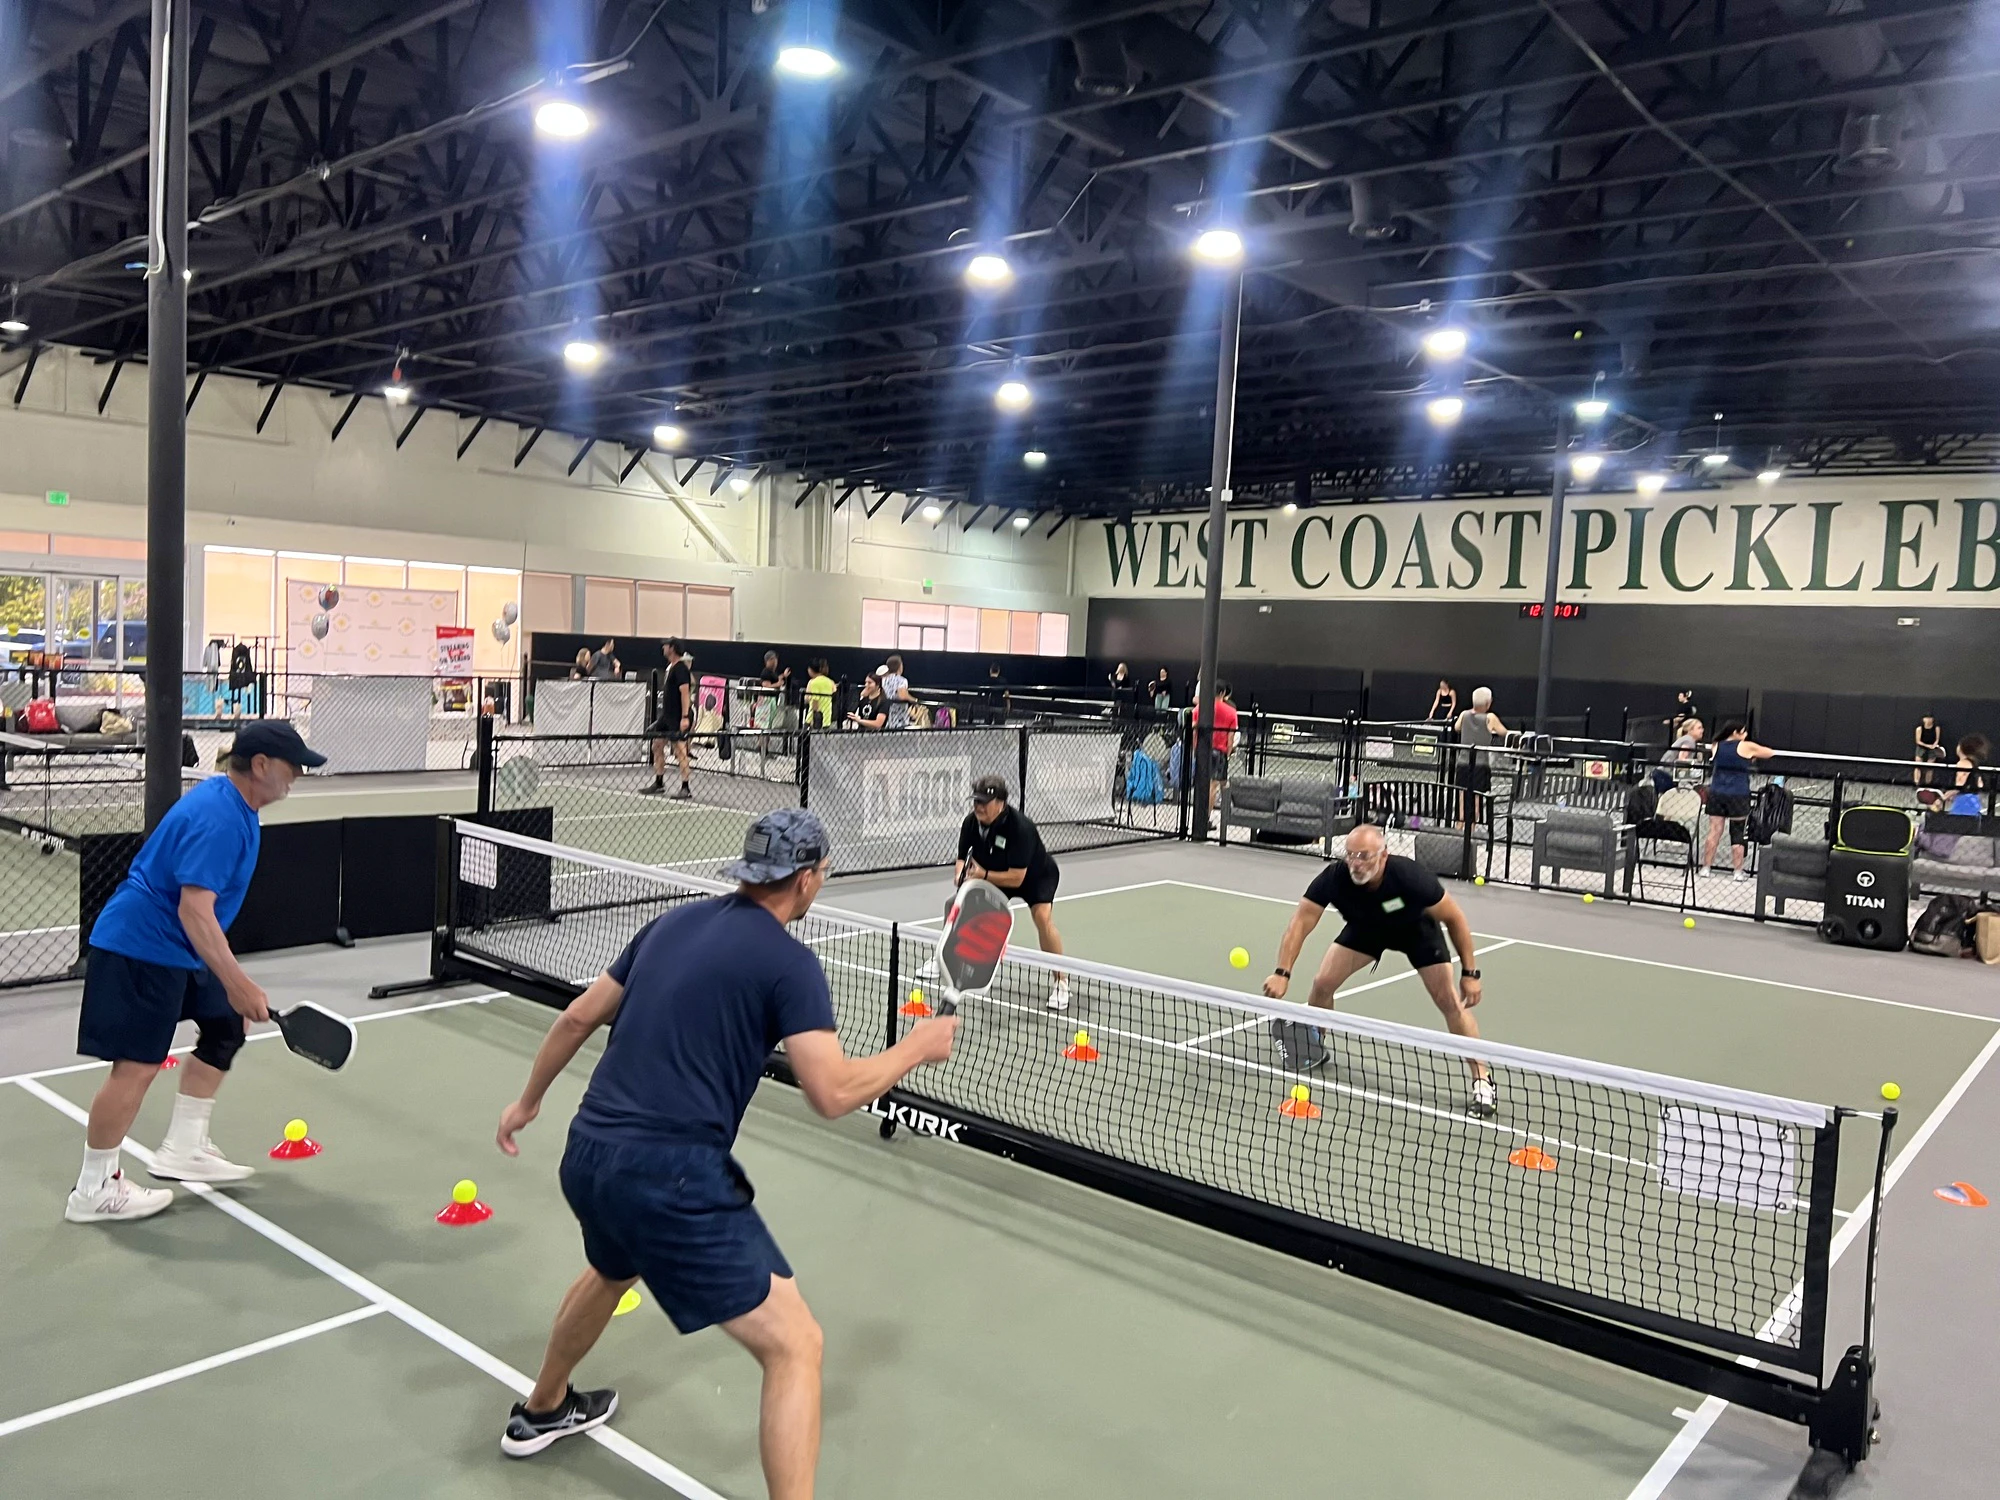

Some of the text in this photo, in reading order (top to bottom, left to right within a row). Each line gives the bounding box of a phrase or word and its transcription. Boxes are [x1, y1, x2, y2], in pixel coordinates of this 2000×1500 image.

[1291, 509, 1542, 590] COAST
[1564, 498, 2000, 592] PICKLEB
[1845, 894, 1885, 909] TITAN
[861, 1097, 962, 1142] LKIRK
